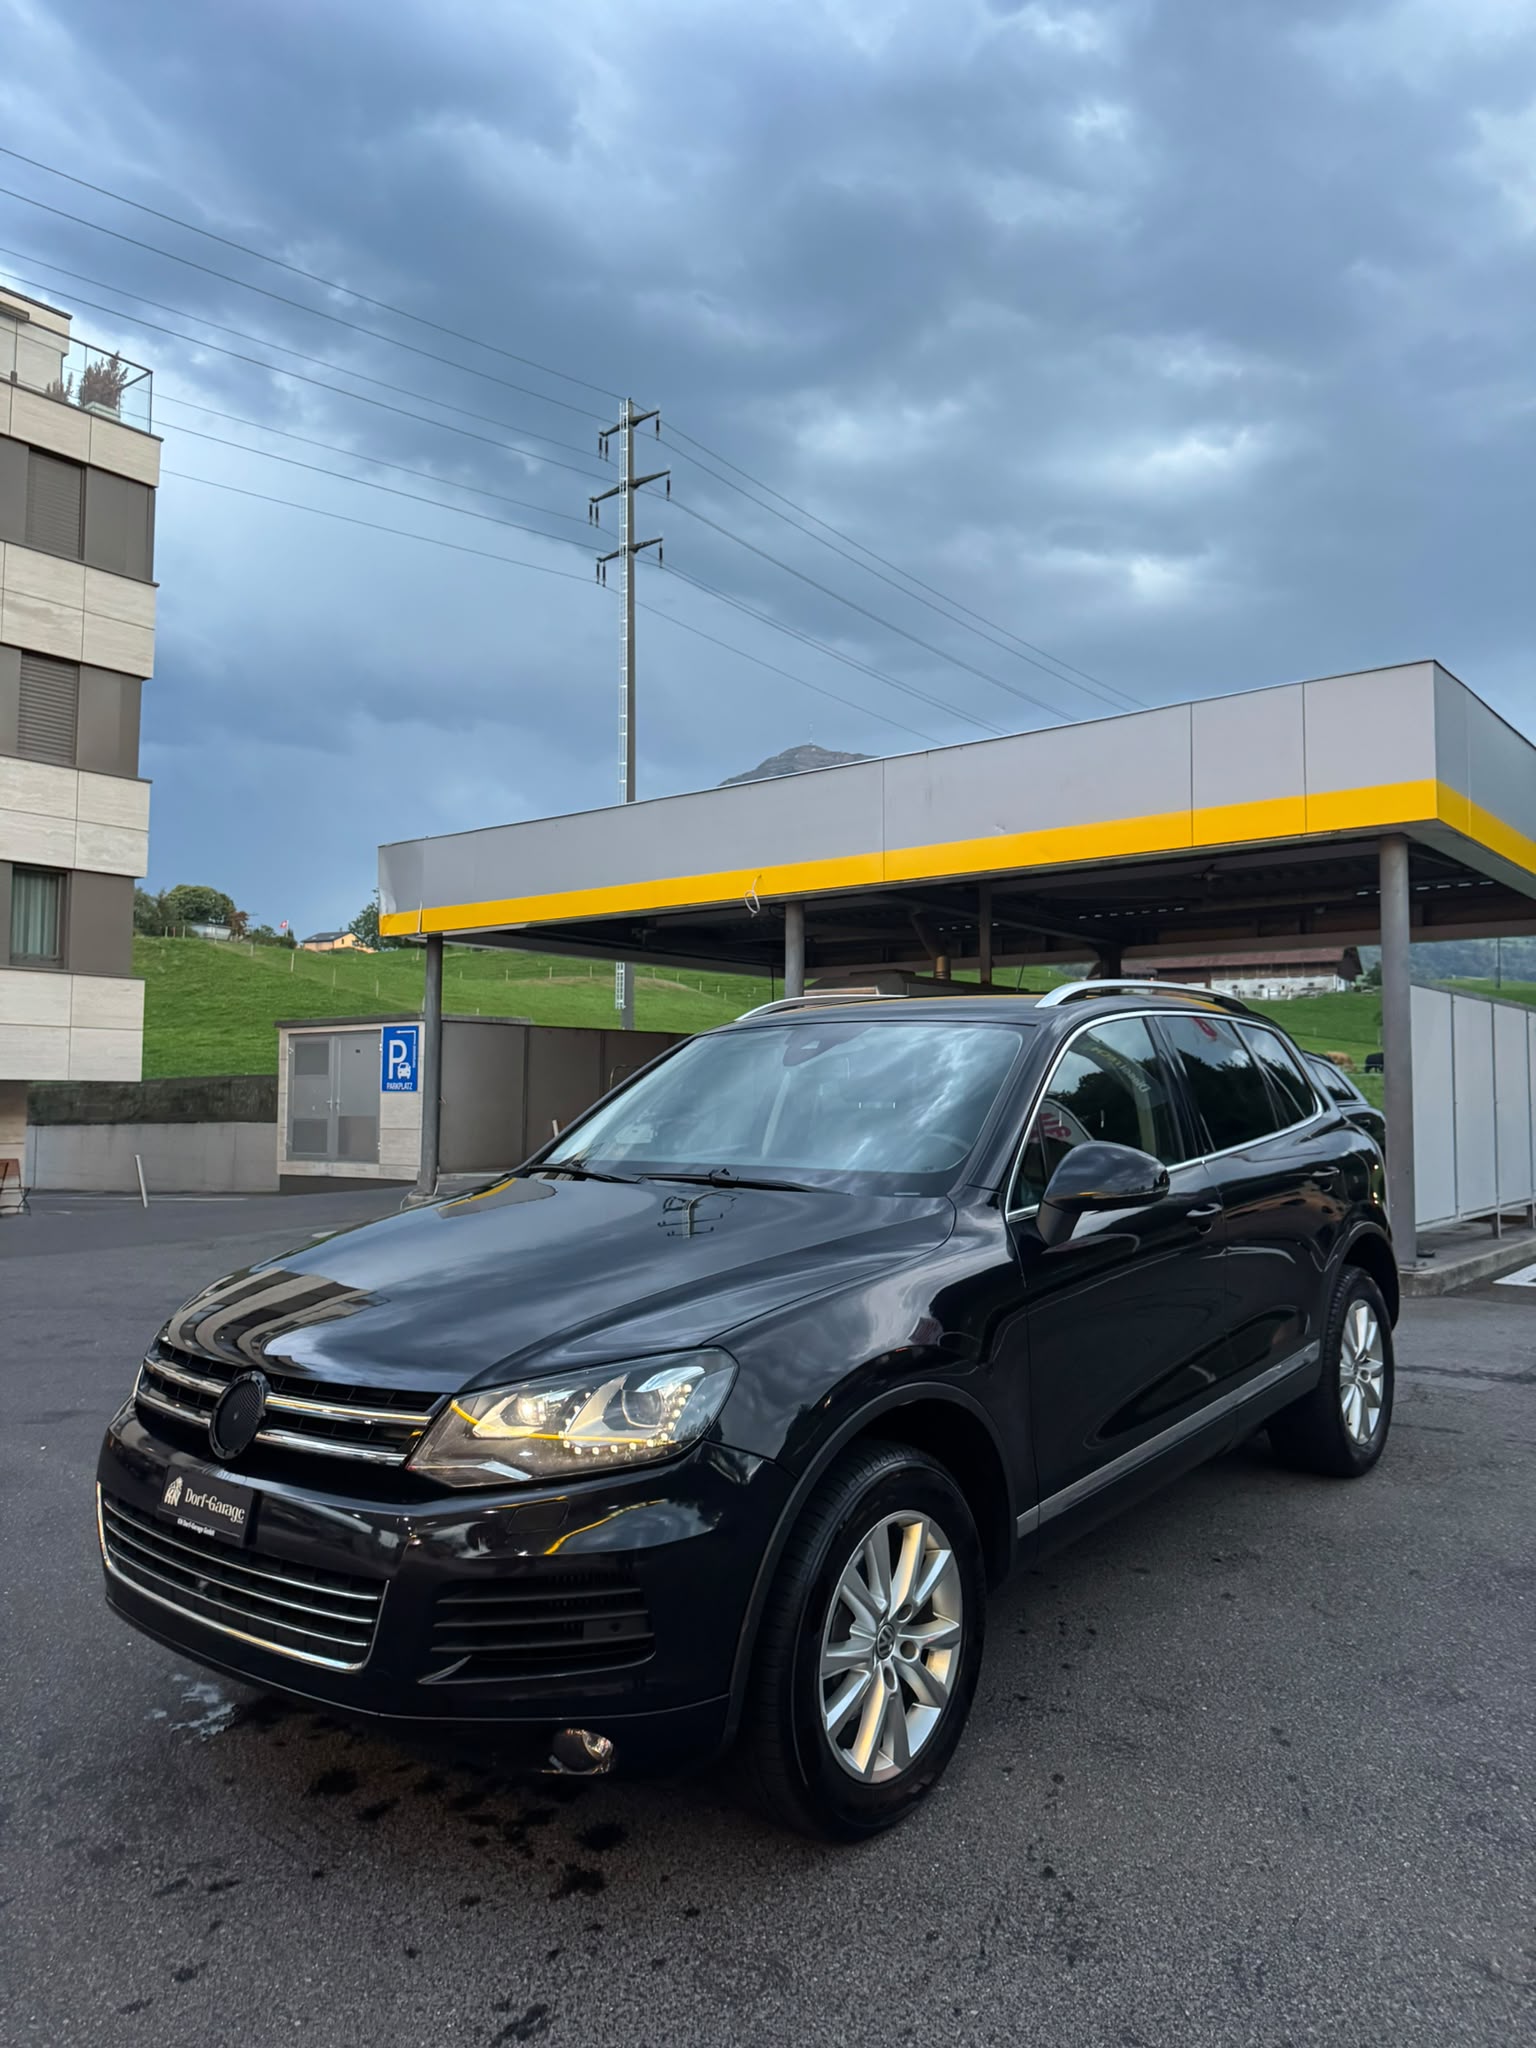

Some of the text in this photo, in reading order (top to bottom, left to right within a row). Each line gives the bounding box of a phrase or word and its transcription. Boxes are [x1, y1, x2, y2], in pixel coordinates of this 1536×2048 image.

[388, 1039, 407, 1080] P
[386, 1082, 413, 1091] PARKPLATZ
[185, 1488, 246, 1523] Dorf-Garage
